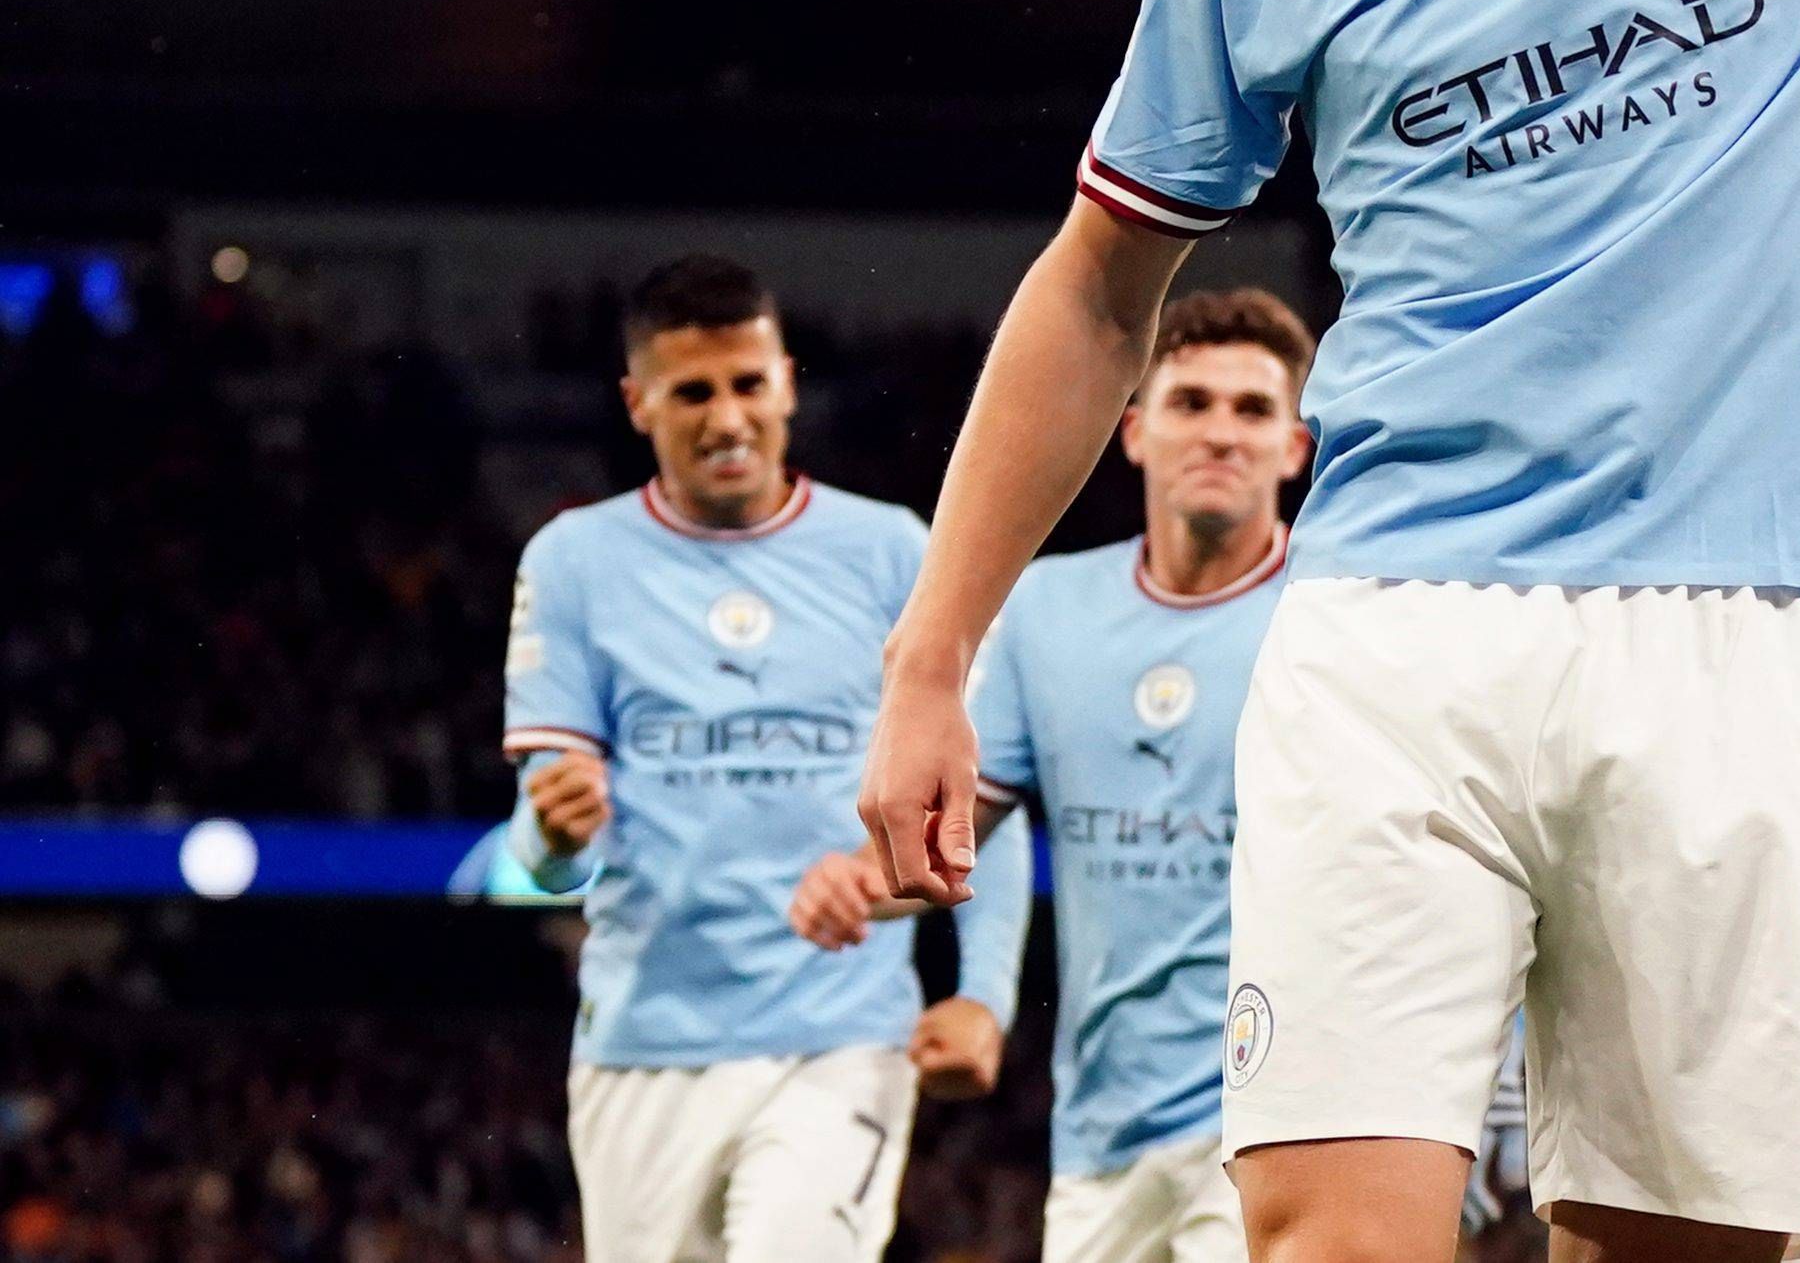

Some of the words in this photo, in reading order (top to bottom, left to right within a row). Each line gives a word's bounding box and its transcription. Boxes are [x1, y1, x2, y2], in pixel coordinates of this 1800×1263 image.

[1465, 71, 1717, 179] AIRWAYS
[631, 714, 858, 759] ETIHAD
[853, 1109, 888, 1205] 7
